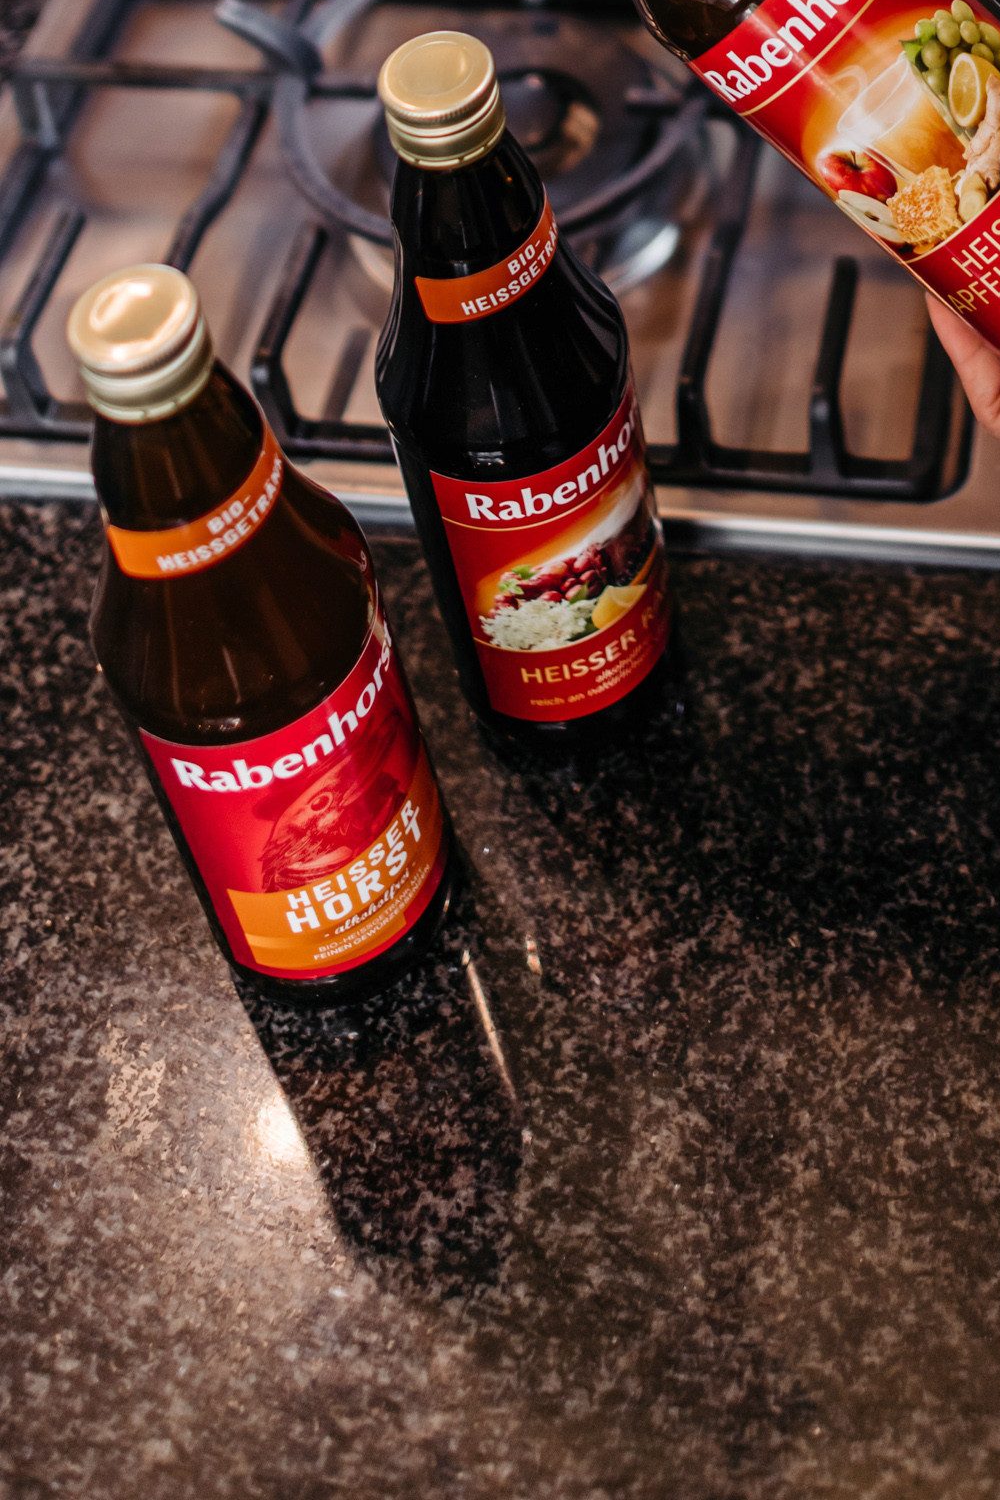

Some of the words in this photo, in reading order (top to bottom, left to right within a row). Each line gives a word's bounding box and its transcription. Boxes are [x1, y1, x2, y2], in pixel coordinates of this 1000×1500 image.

[507, 239, 541, 276] BIO-
[207, 495, 252, 535] BIO-
[520, 629, 637, 684] HEISSER
[285, 806, 422, 933] HORST
[287, 800, 415, 910] HEISSER
